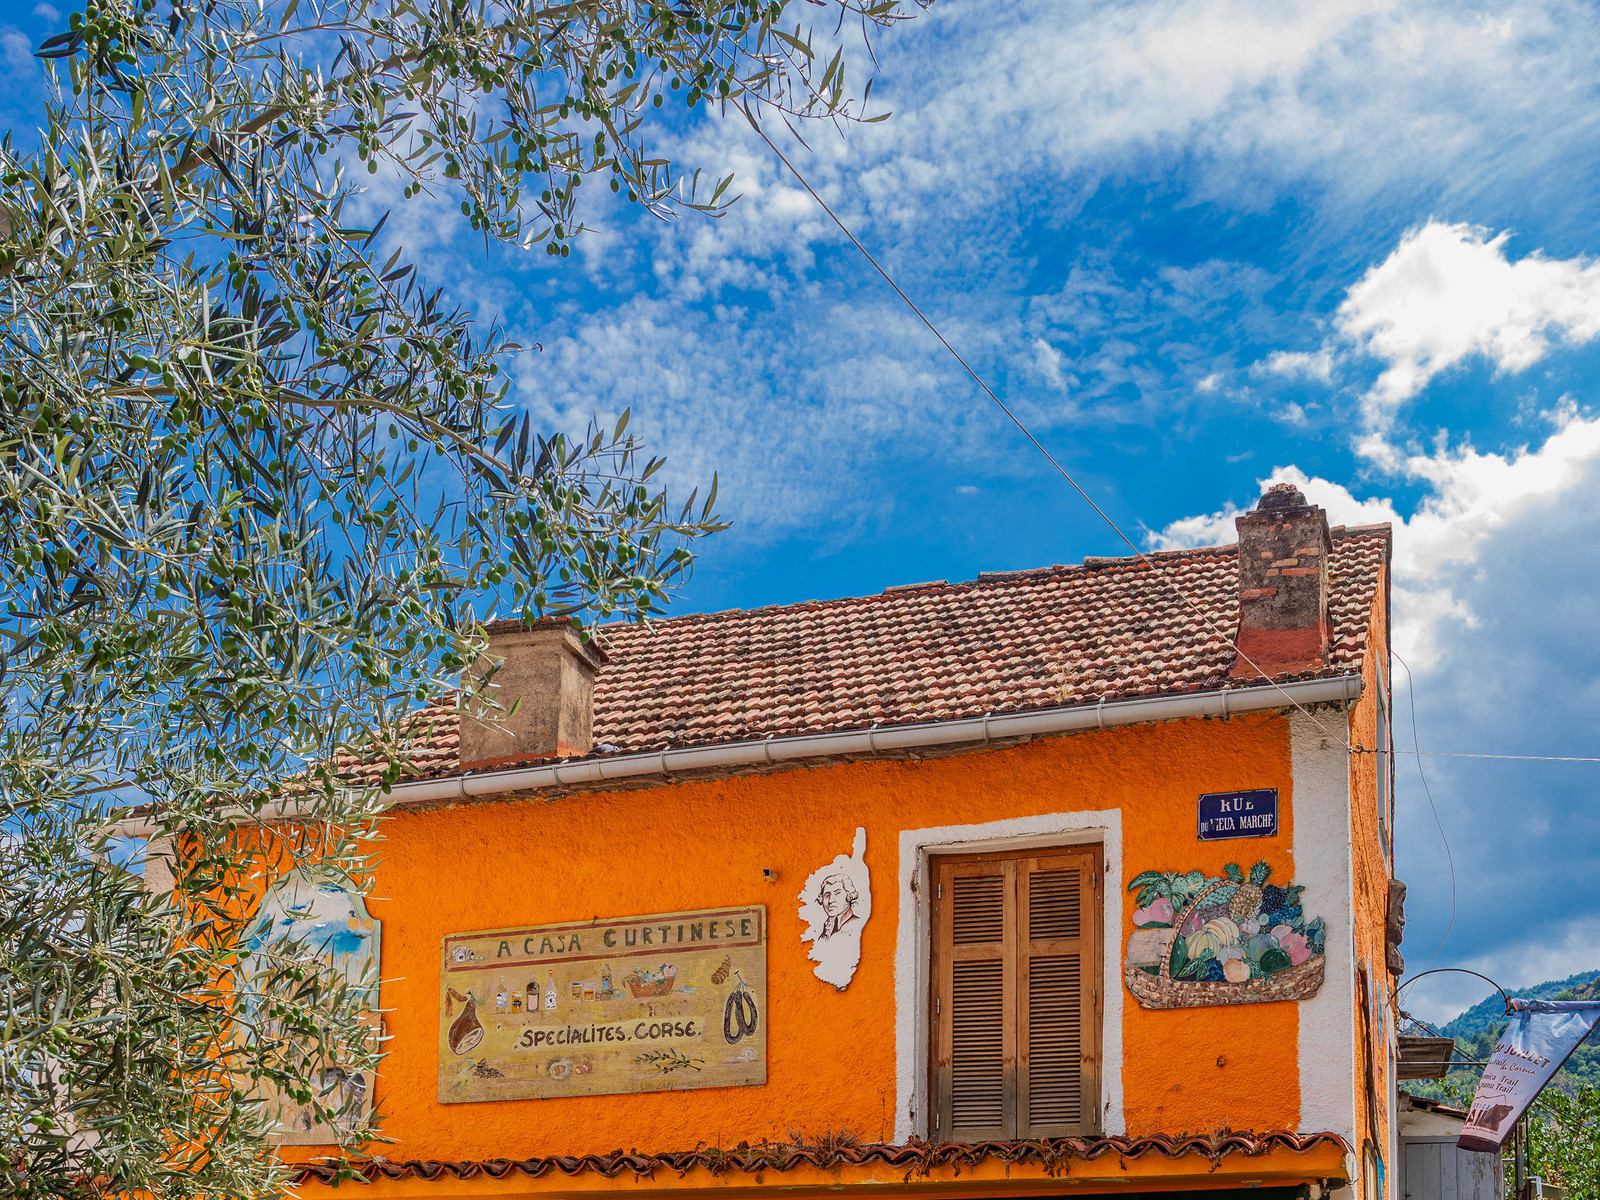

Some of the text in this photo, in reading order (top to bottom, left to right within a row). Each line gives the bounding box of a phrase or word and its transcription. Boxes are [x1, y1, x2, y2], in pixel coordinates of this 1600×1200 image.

[1220, 798, 1254, 813] RUE
[496, 918, 752, 958] A CASA CURTINESE
[1500, 1075, 1519, 1086] Trail
[1496, 1083, 1513, 1093] Trail
